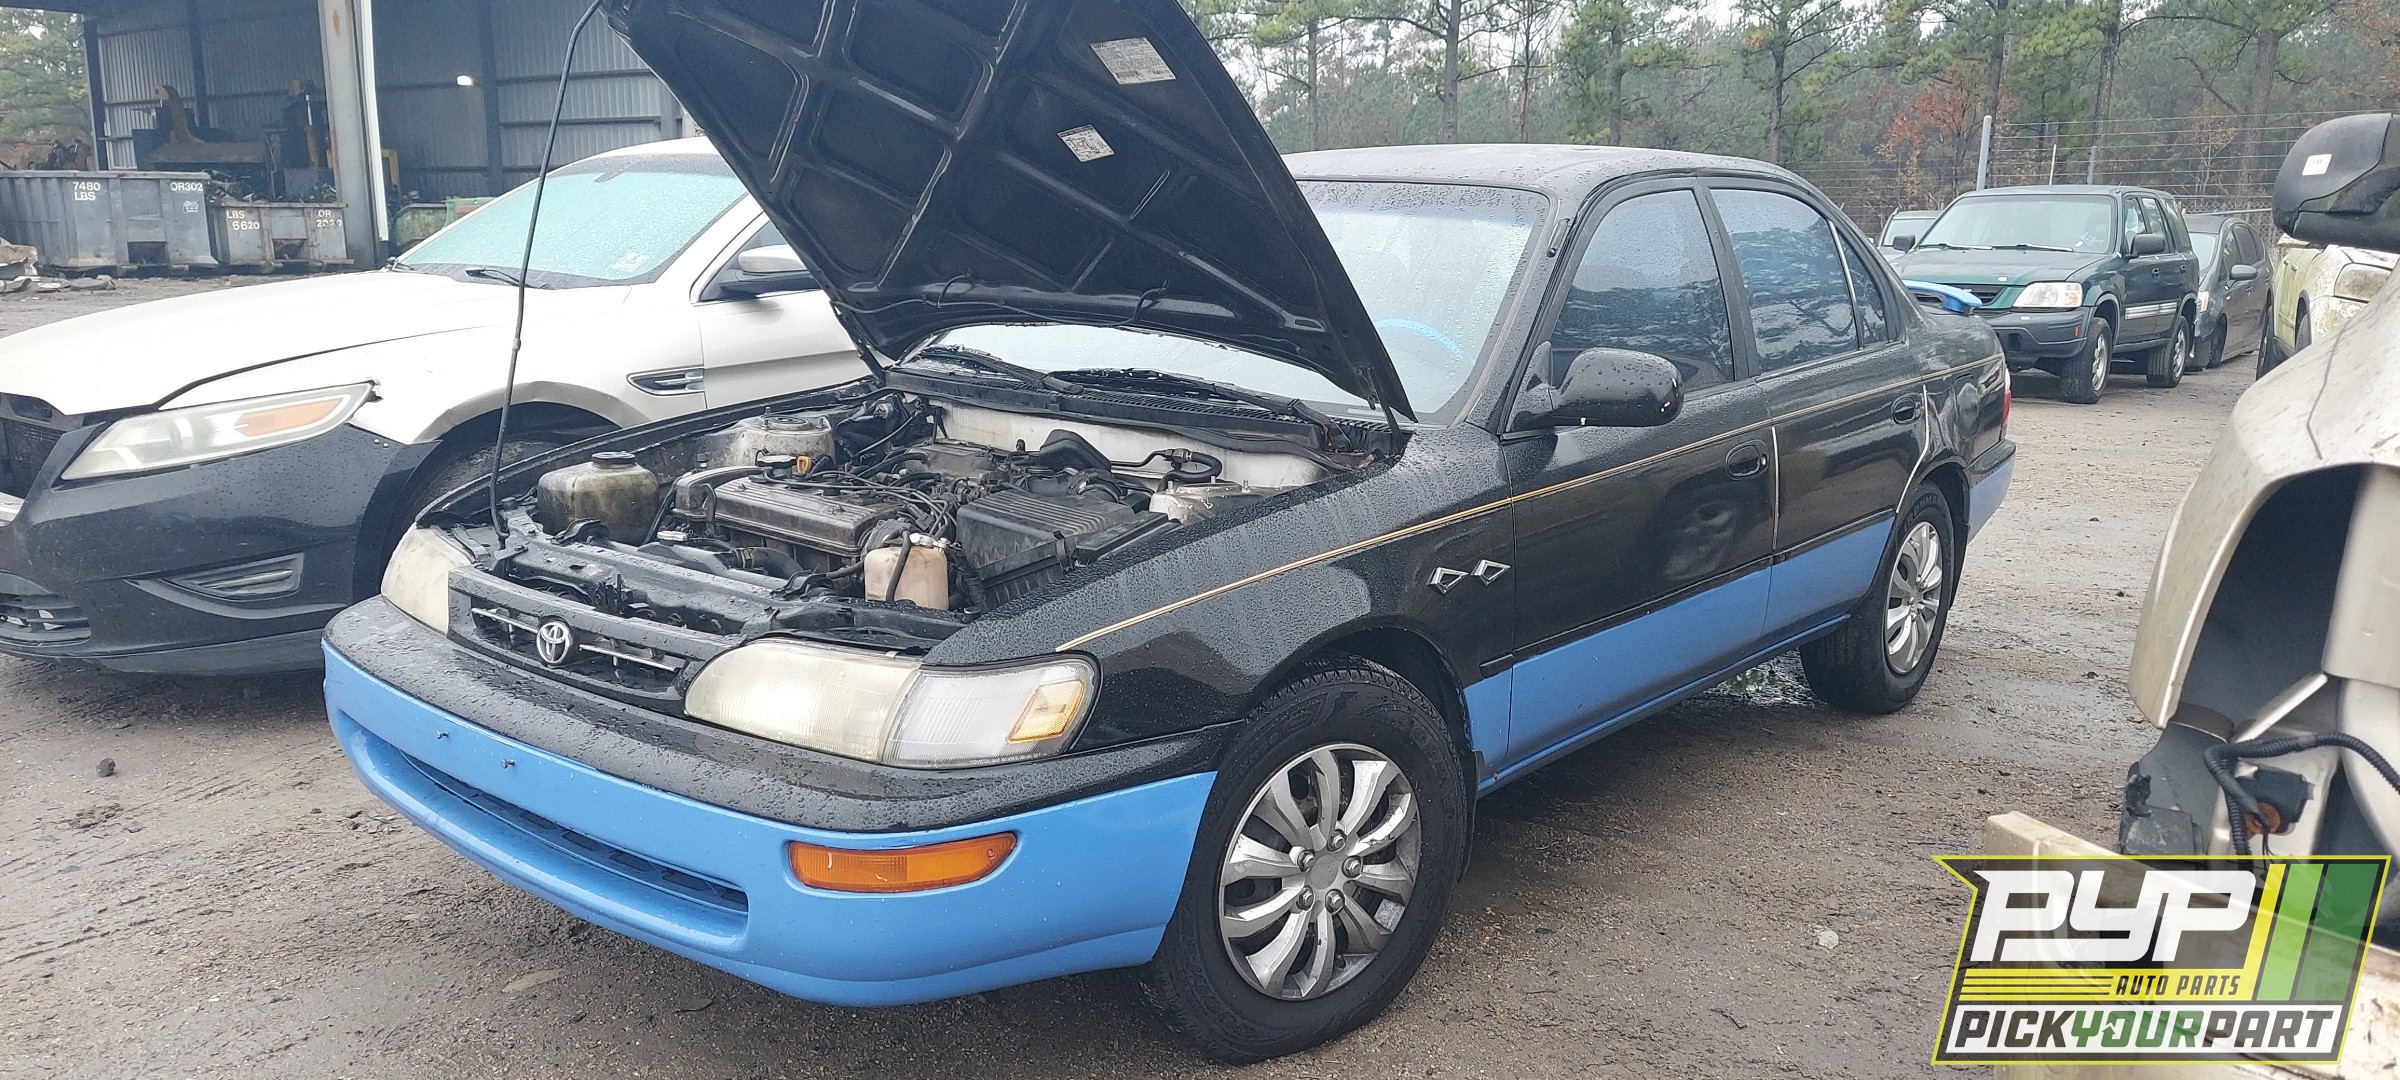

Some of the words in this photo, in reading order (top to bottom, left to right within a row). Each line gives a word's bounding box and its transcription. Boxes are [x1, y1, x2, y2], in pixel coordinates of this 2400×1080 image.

[73, 182, 101, 191] 7480
[169, 182, 203, 191] OR302
[74, 191, 97, 201] LBS
[226, 210, 246, 219] LBS
[318, 209, 332, 218] OR
[232, 220, 260, 230] 6620
